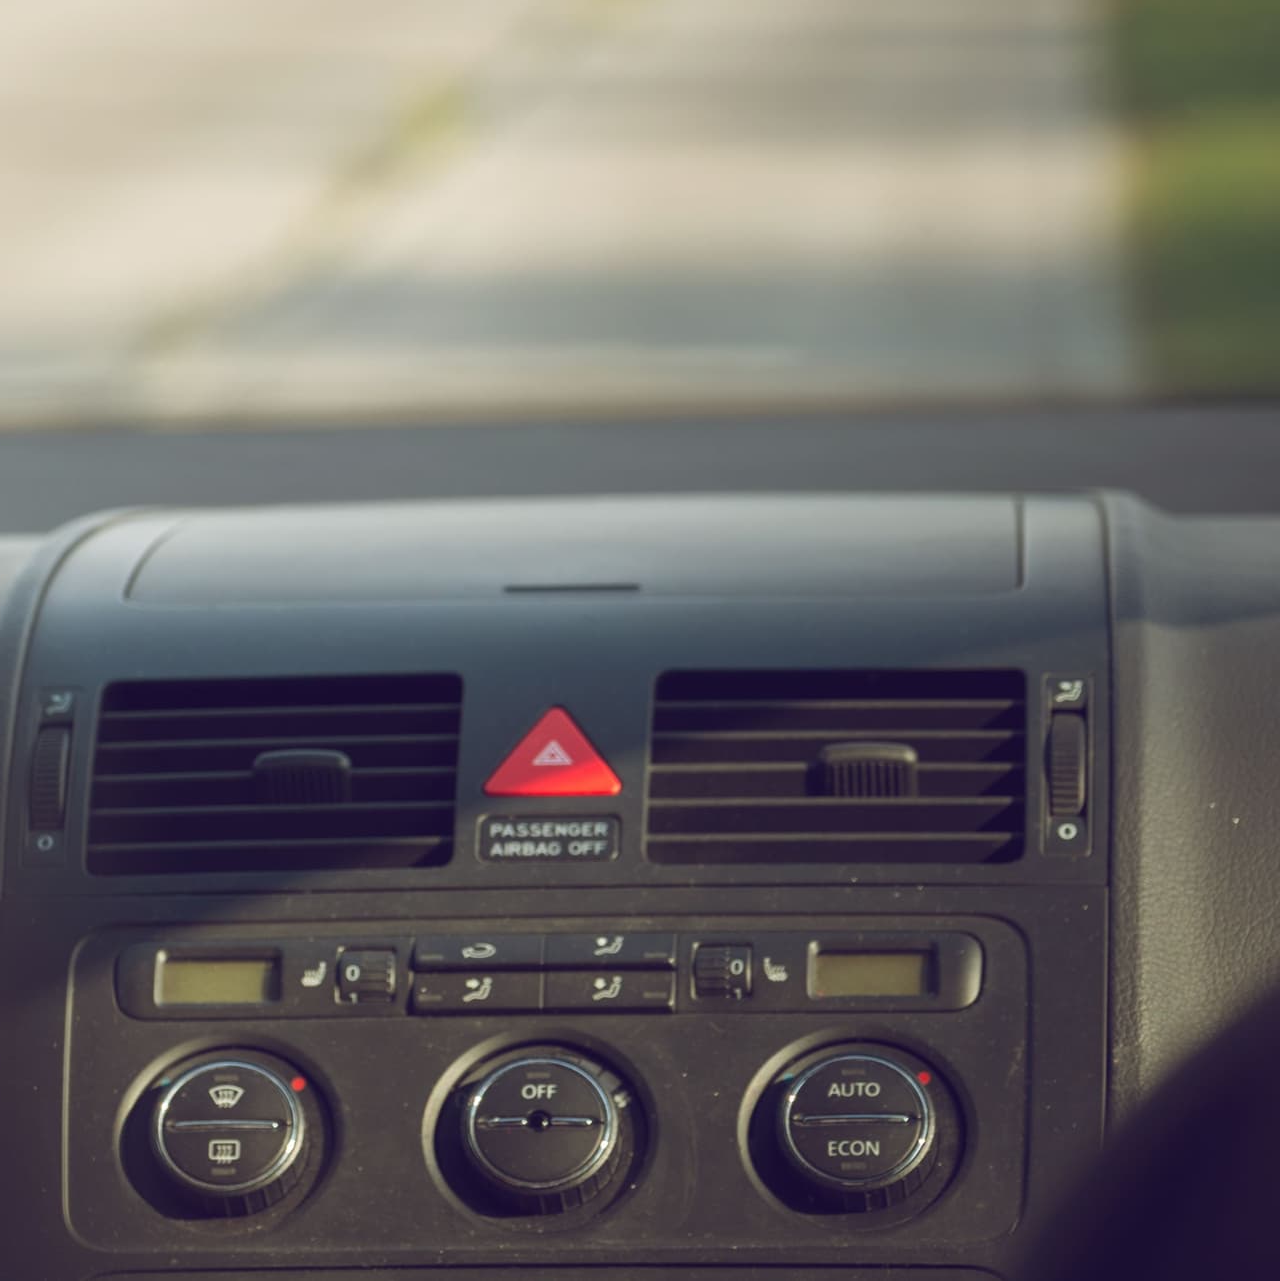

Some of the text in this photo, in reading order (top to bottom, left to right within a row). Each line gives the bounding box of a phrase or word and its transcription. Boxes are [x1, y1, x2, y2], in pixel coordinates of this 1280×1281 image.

[489, 821, 609, 838] PASSENGER
[489, 839, 609, 857] AIRBAG OFF
[521, 1083, 559, 1100] OFF
[827, 1081, 881, 1098] AUTO
[827, 1140, 881, 1157] ECON
